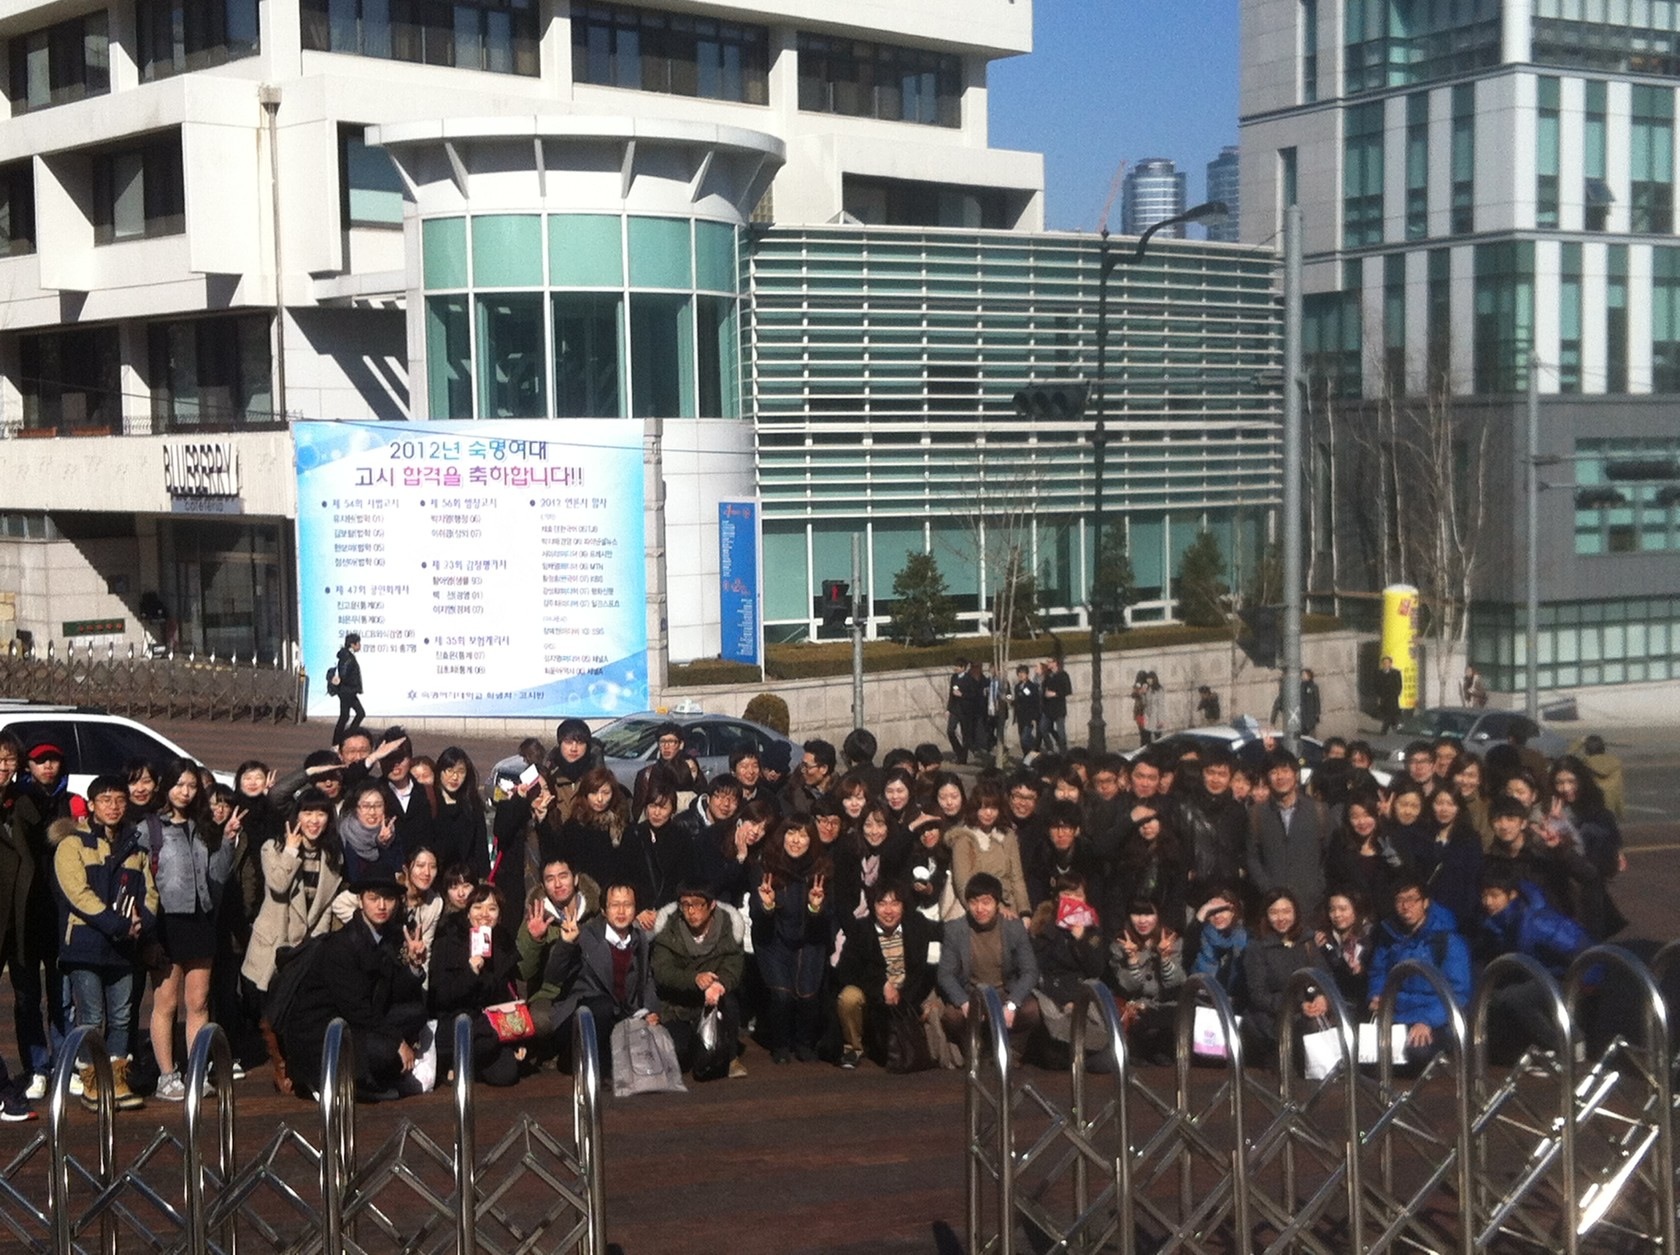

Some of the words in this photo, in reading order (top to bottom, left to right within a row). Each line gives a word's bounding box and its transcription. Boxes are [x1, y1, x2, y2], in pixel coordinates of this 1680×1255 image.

[390, 440, 461, 461] 2012년
[468, 440, 548, 461] 숙명여대
[355, 466, 394, 487] 고시
[403, 466, 462, 487] 합격을
[469, 466, 583, 487] 축하합니다!!
